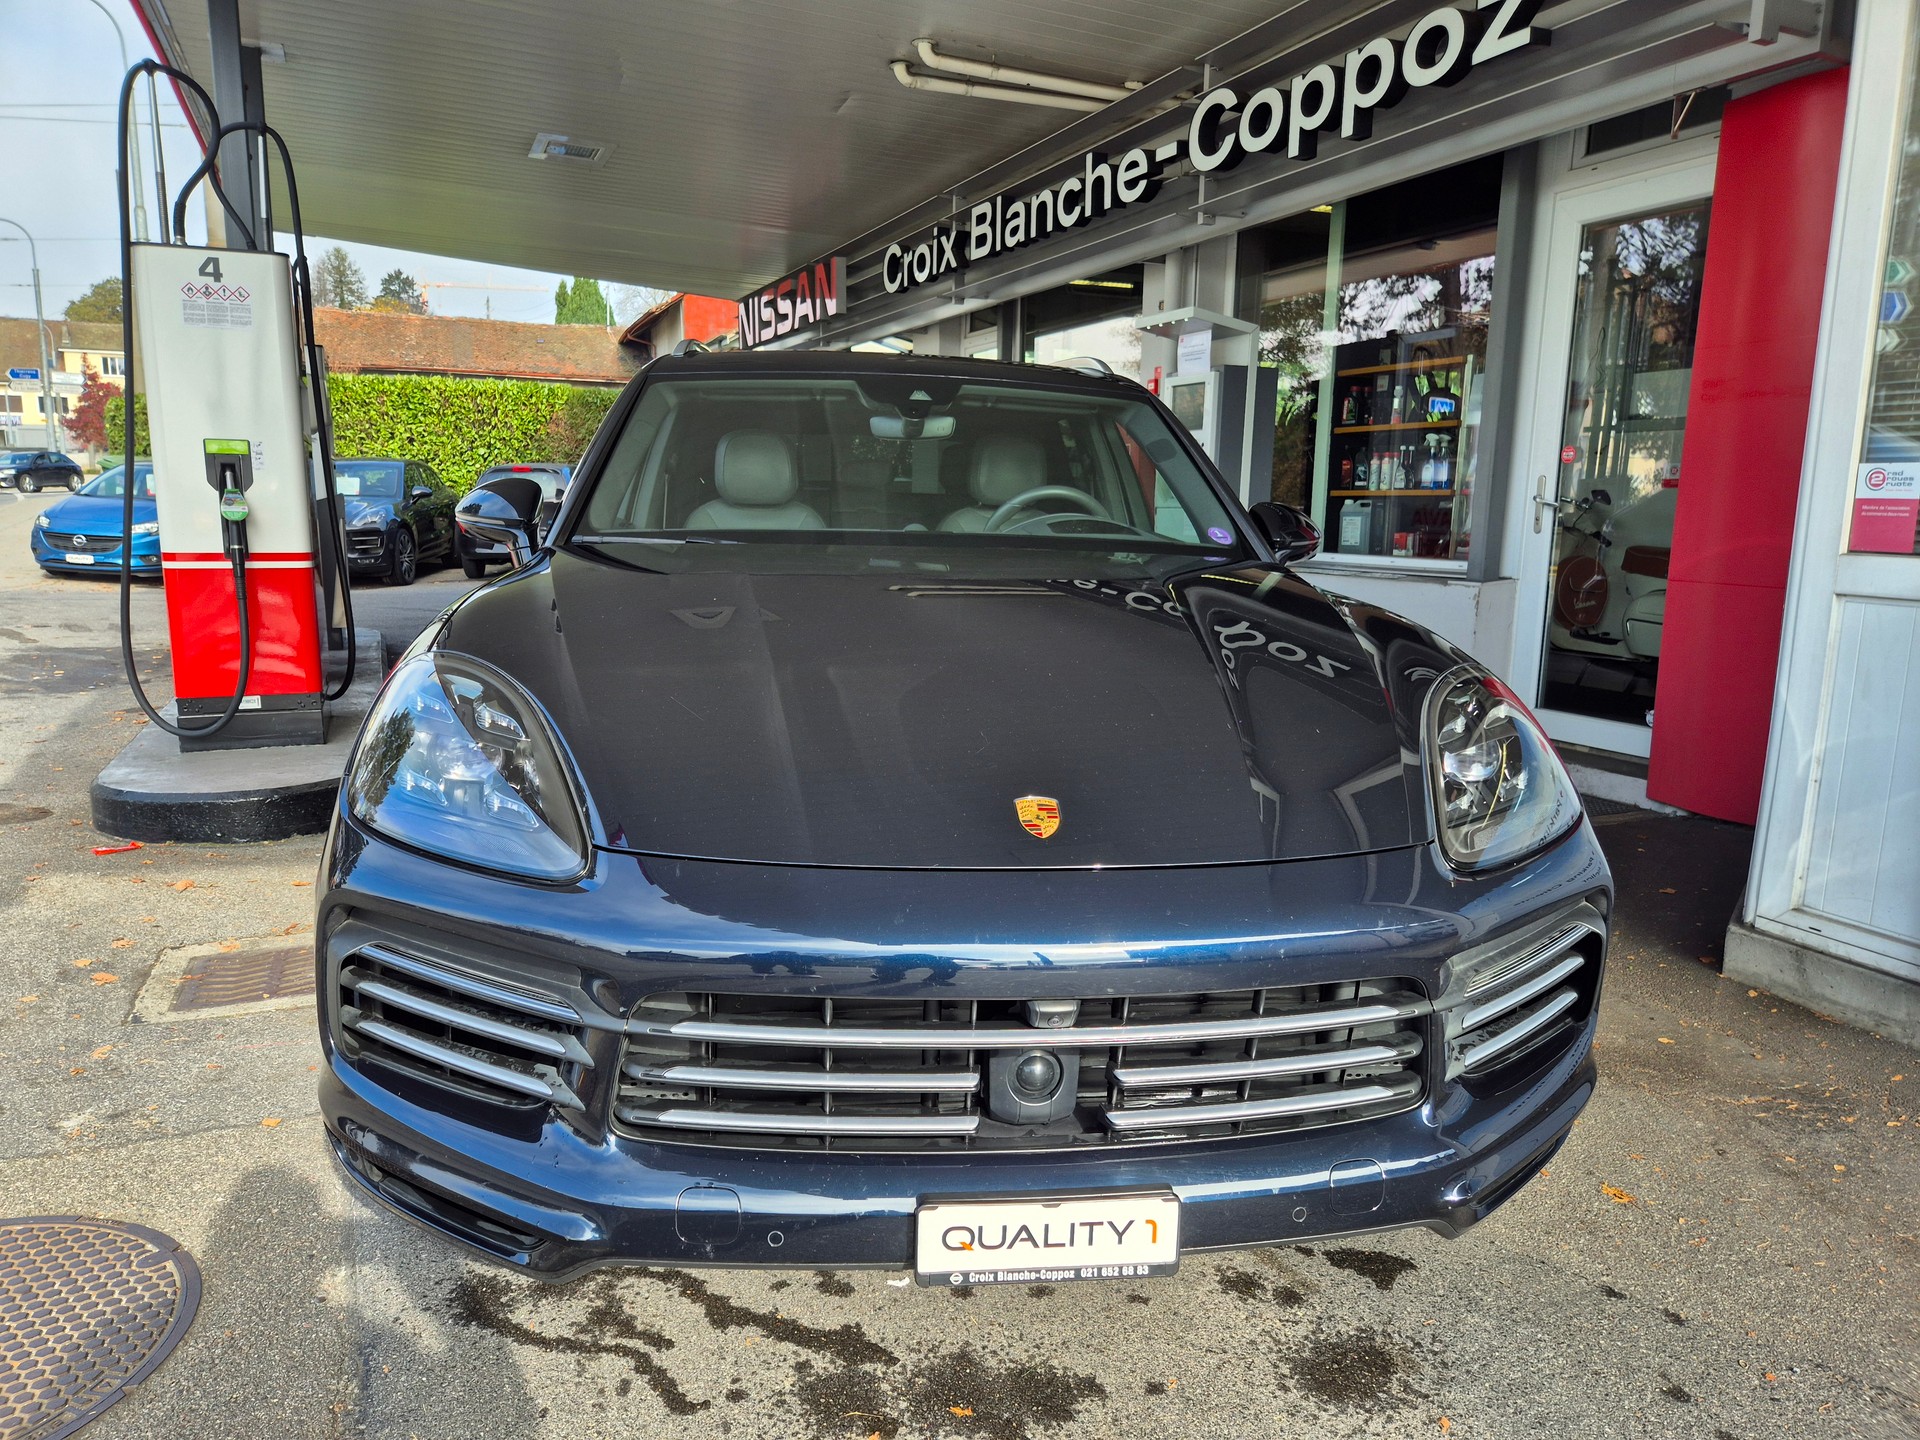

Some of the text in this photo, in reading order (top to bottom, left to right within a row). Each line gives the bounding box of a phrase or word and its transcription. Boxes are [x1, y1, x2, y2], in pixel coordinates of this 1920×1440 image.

[198, 256, 224, 283] 4
[883, 227, 958, 293] Croix
[739, 256, 837, 350] NISSAN
[941, 1219, 1158, 1252] QUALITY 1
[969, 1265, 1149, 1283] Croix Blanche-Coppoz 021 652 68 83
